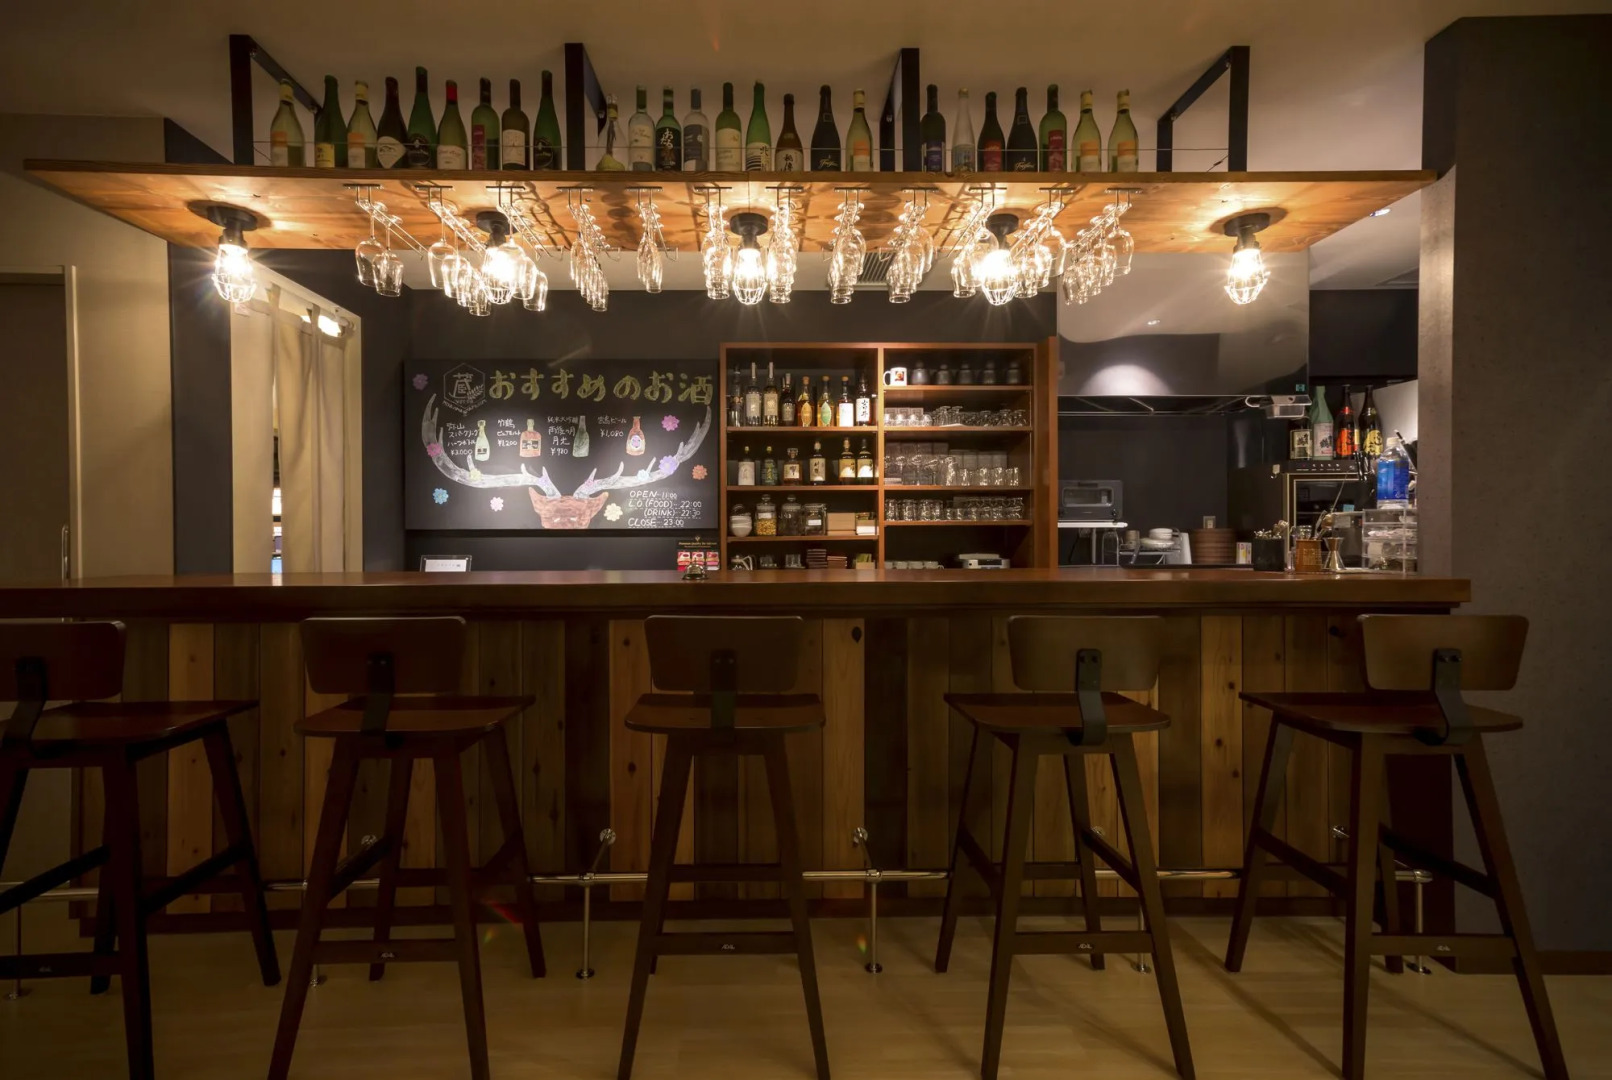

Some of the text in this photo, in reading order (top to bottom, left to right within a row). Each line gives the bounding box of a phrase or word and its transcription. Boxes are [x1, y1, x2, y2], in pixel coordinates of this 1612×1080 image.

[489, 368, 714, 405] おすすめのお酒
[552, 435, 571, 446] 月光
[629, 490, 658, 498] OPEN
[680, 500, 702, 508] 22:00
[627, 517, 657, 527] CLOSE
